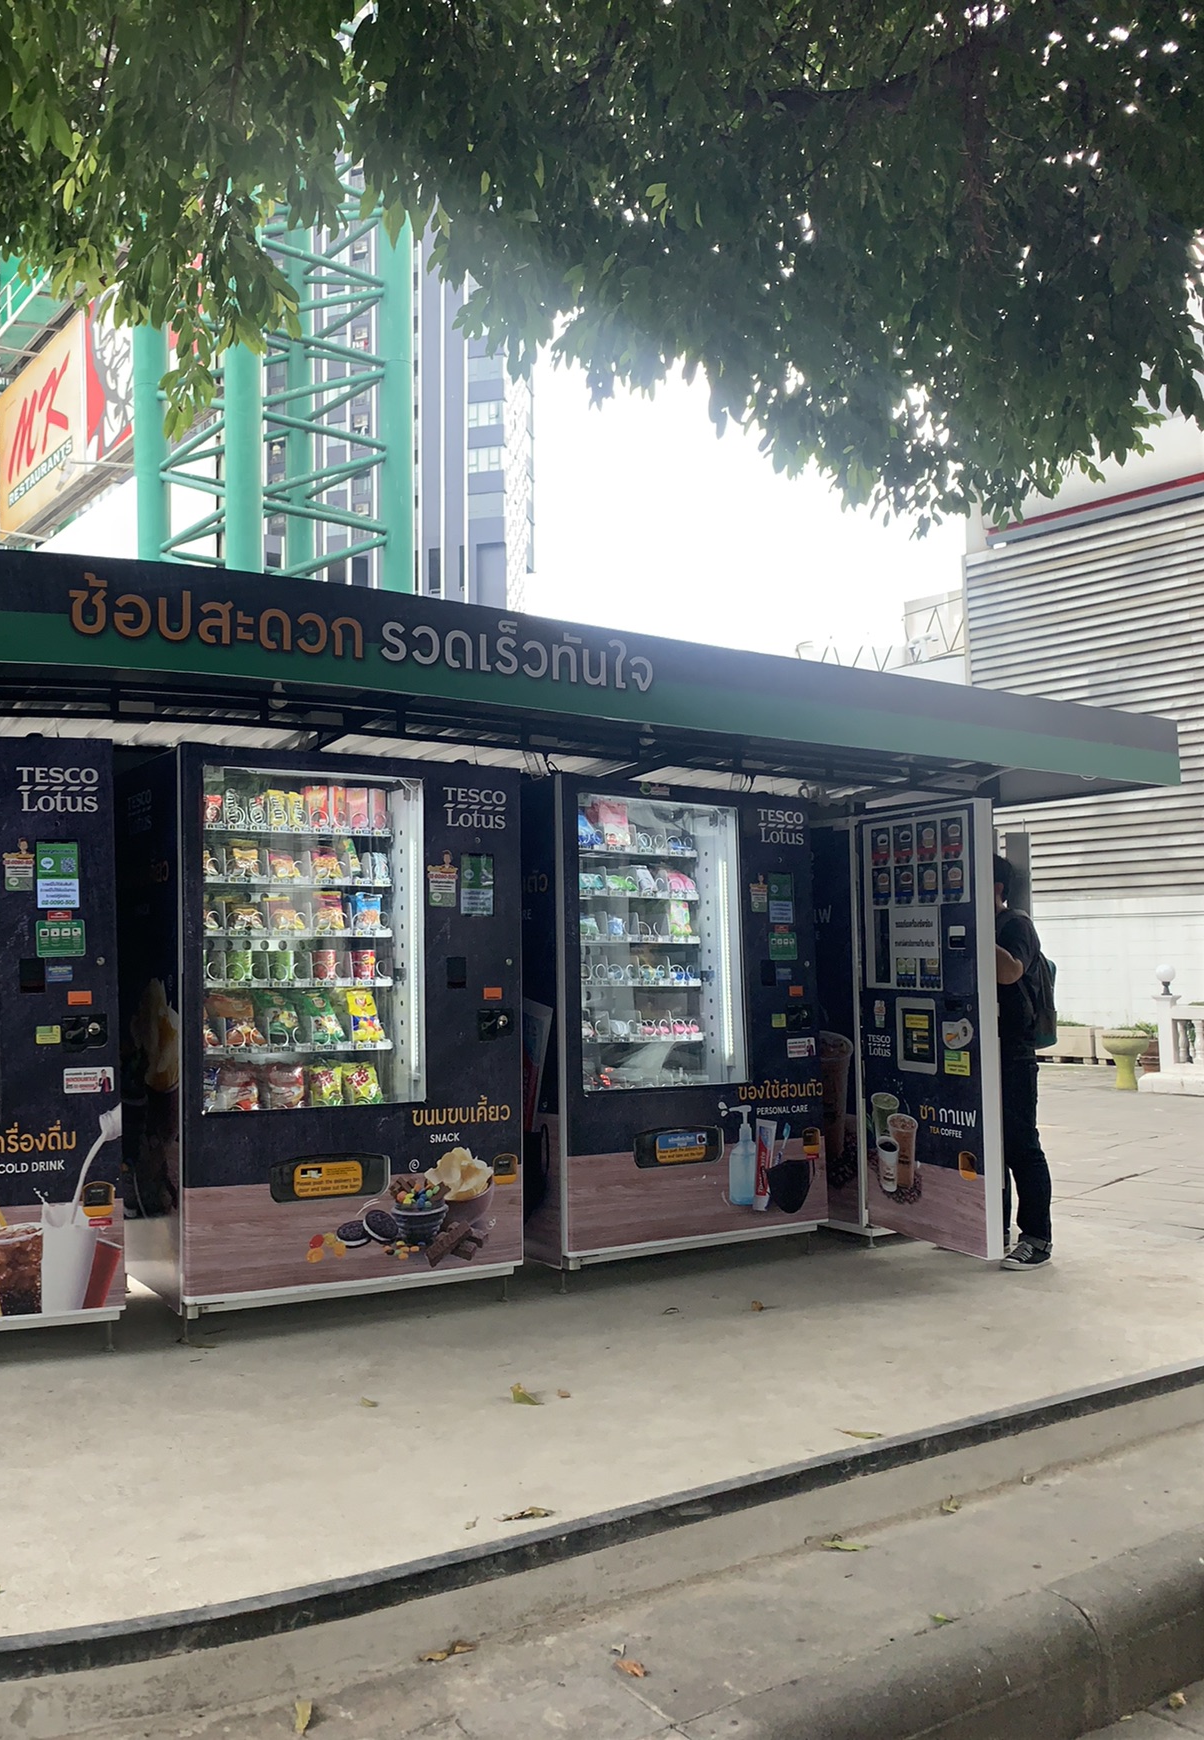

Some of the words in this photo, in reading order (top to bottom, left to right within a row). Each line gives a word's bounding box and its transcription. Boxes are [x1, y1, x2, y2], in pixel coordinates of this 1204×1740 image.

[8, 436, 74, 508] RESTAURANTS
[69, 573, 365, 660] ช้อปสะดวก
[379, 620, 654, 693] รวดเร็วทันใจ
[16, 767, 99, 784] TESCO
[21, 792, 98, 812] Lotus
[442, 787, 507, 805] TESCO
[446, 808, 506, 830] Lotus
[757, 808, 804, 825] TESCO
[760, 827, 804, 845] Lotus
[868, 1034, 891, 1044] TESCO
[869, 1046, 891, 1057] Lotus
[738, 1079, 823, 1101] ของใช้ส่วนตัว
[412, 1095, 511, 1126] ขนมขบเคี้ยว
[756, 1106, 790, 1116] PERSONAL
[791, 1104, 808, 1114] CARE
[920, 1105, 936, 1121] ชา
[939, 1107, 977, 1128] กาแฟ
[430, 1132, 460, 1143] SNACK
[929, 1126, 940, 1135] TEA
[940, 1127, 962, 1139] COFFEE
[31, 1160, 65, 1172] DRINK
